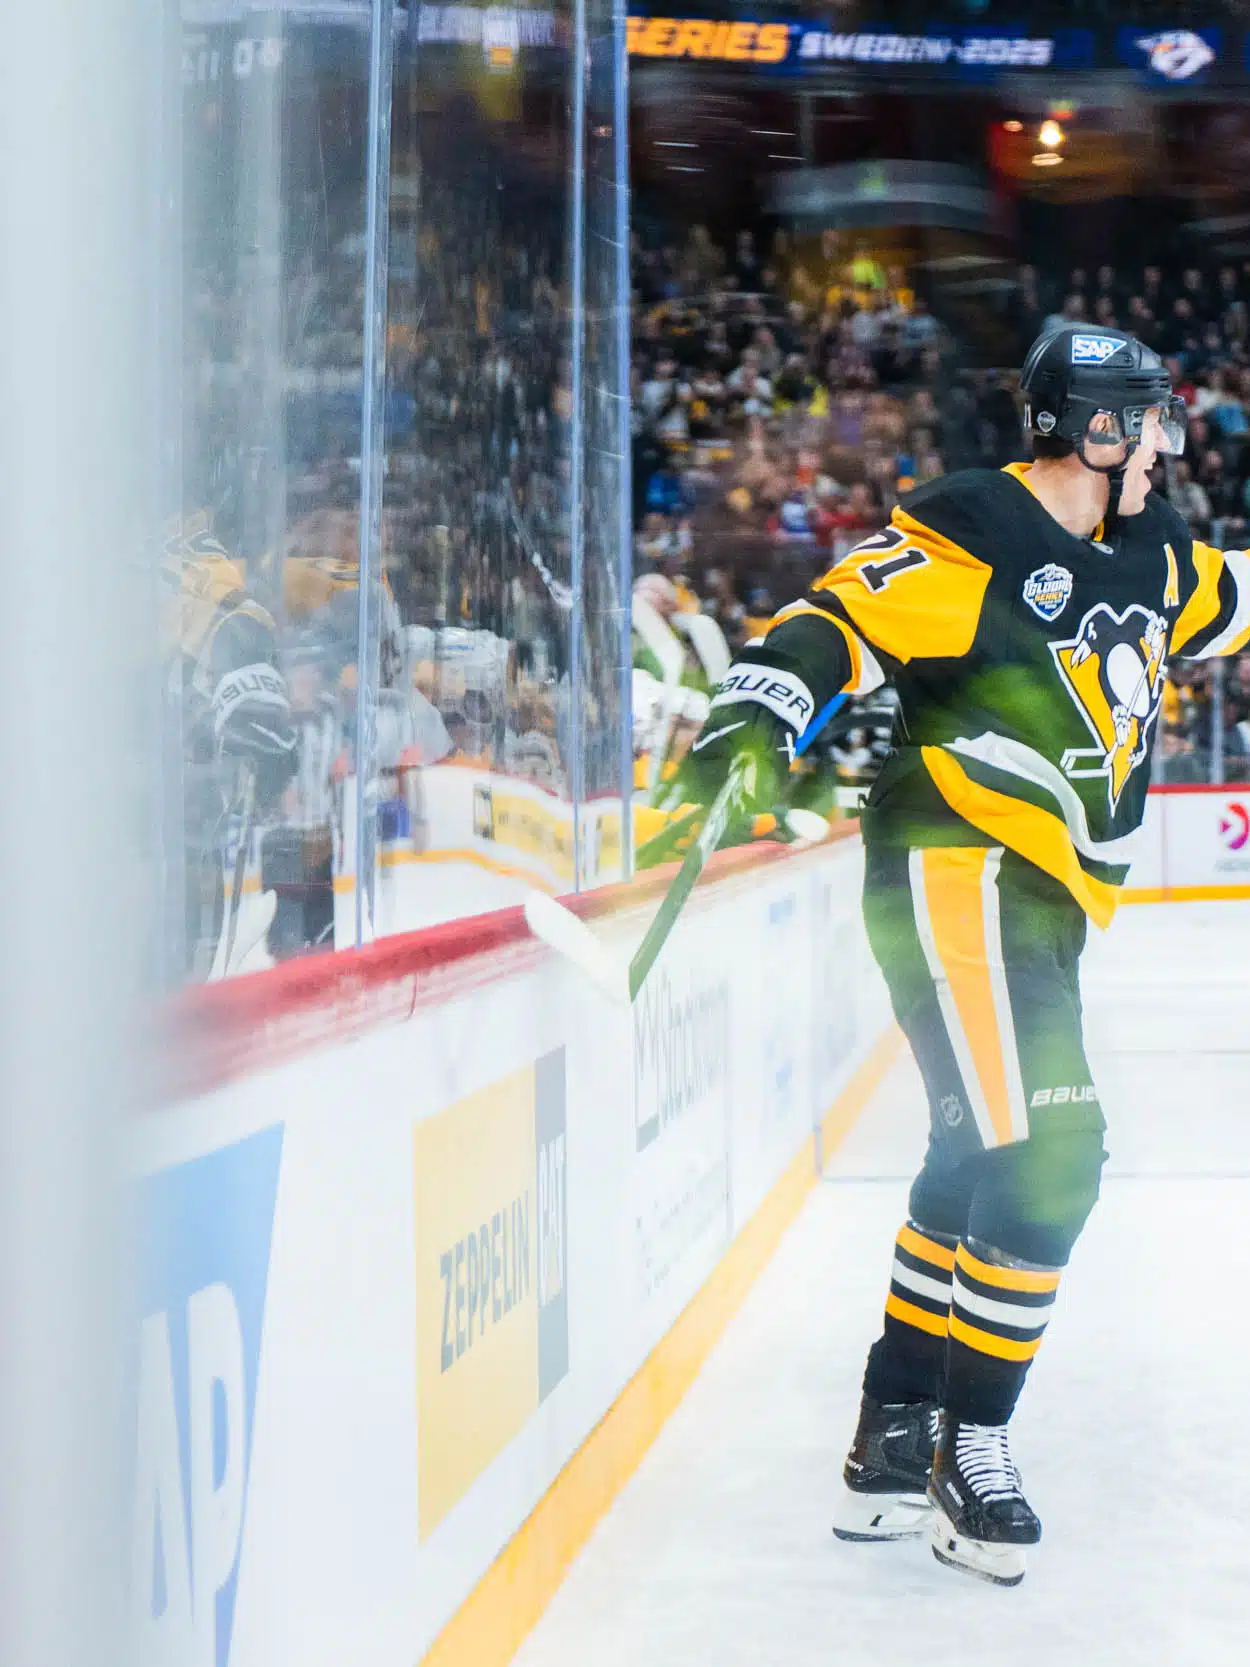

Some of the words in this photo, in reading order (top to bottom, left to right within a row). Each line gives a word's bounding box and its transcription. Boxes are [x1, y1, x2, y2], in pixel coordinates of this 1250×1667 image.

[626, 16, 789, 64] SERIES
[1074, 338, 1115, 357] SAP
[439, 1189, 531, 1375] ZEPPELIN
[128, 1280, 246, 1667] AP
